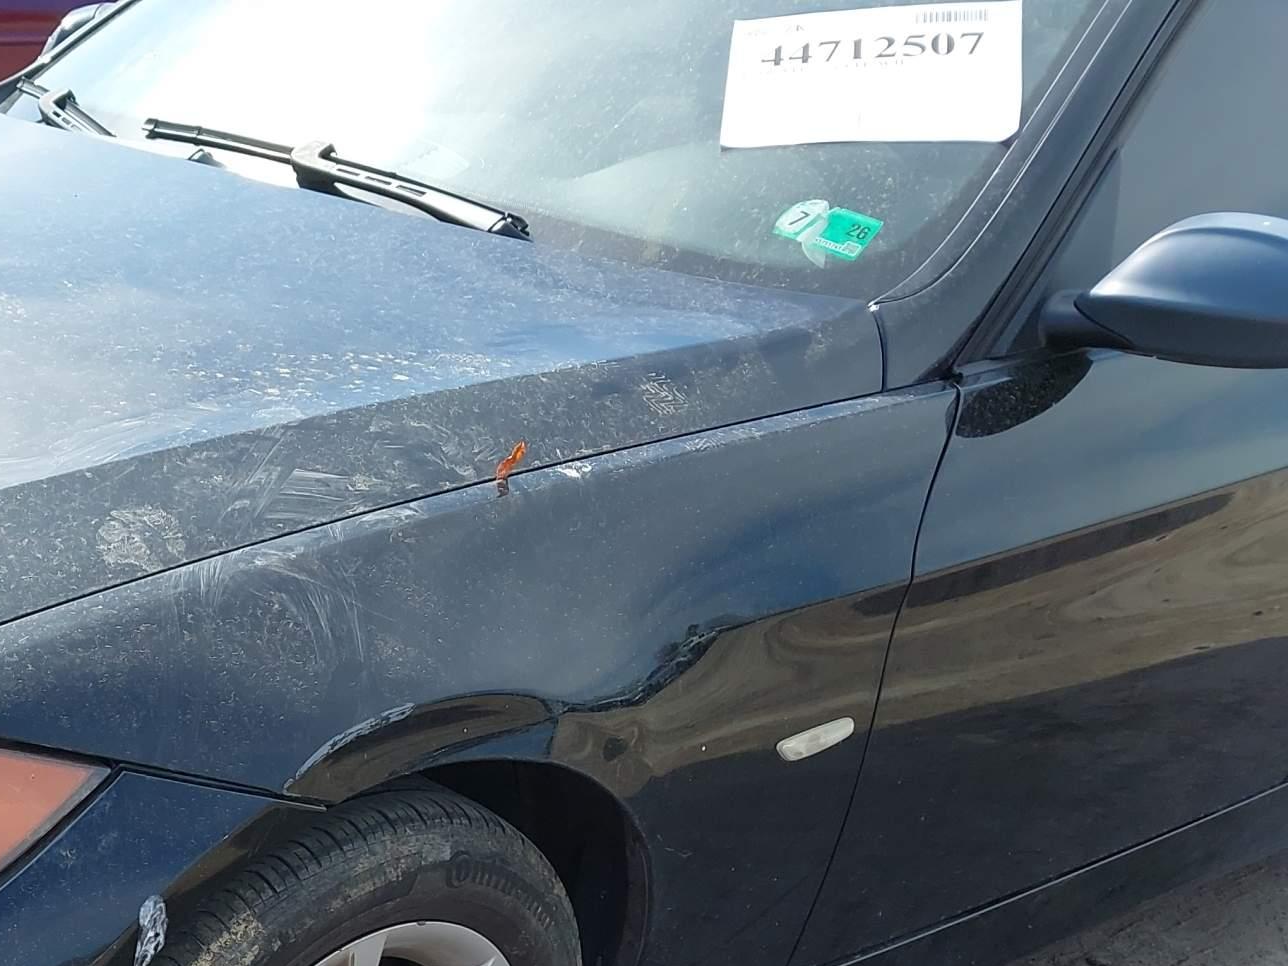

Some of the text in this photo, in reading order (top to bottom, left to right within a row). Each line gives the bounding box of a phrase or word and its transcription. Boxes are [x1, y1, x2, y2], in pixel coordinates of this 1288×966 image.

[760, 31, 985, 67] 44712507
[788, 210, 811, 226] 7
[846, 223, 872, 240] 26
